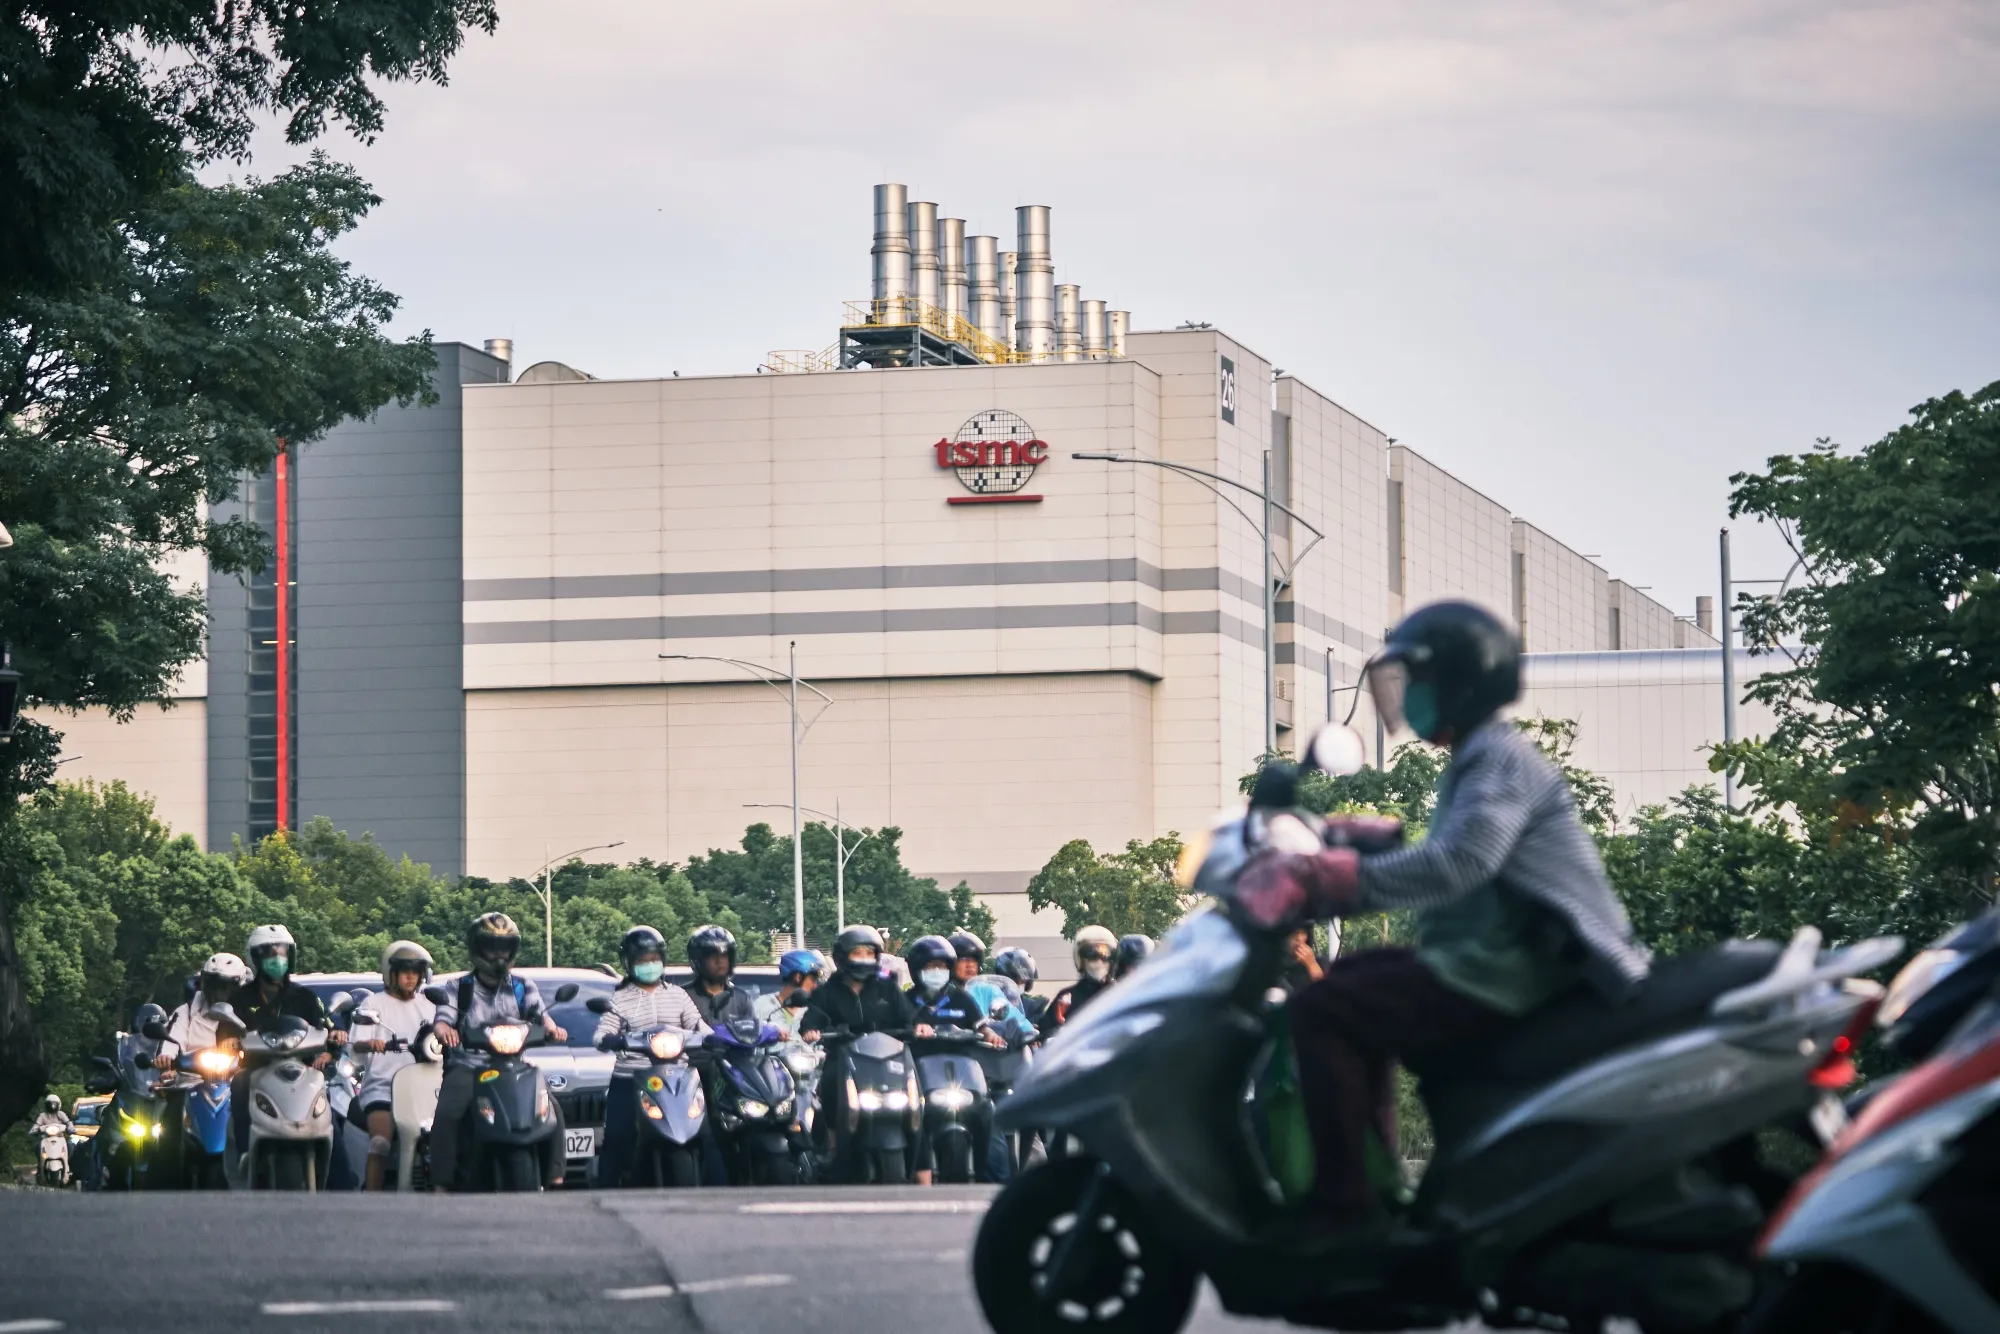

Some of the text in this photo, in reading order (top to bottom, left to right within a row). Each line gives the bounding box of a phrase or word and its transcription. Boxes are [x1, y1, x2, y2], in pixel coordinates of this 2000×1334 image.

[1222, 369, 1235, 411] 26
[934, 437, 1049, 468] tsmc
[566, 1135, 593, 1153] 027
